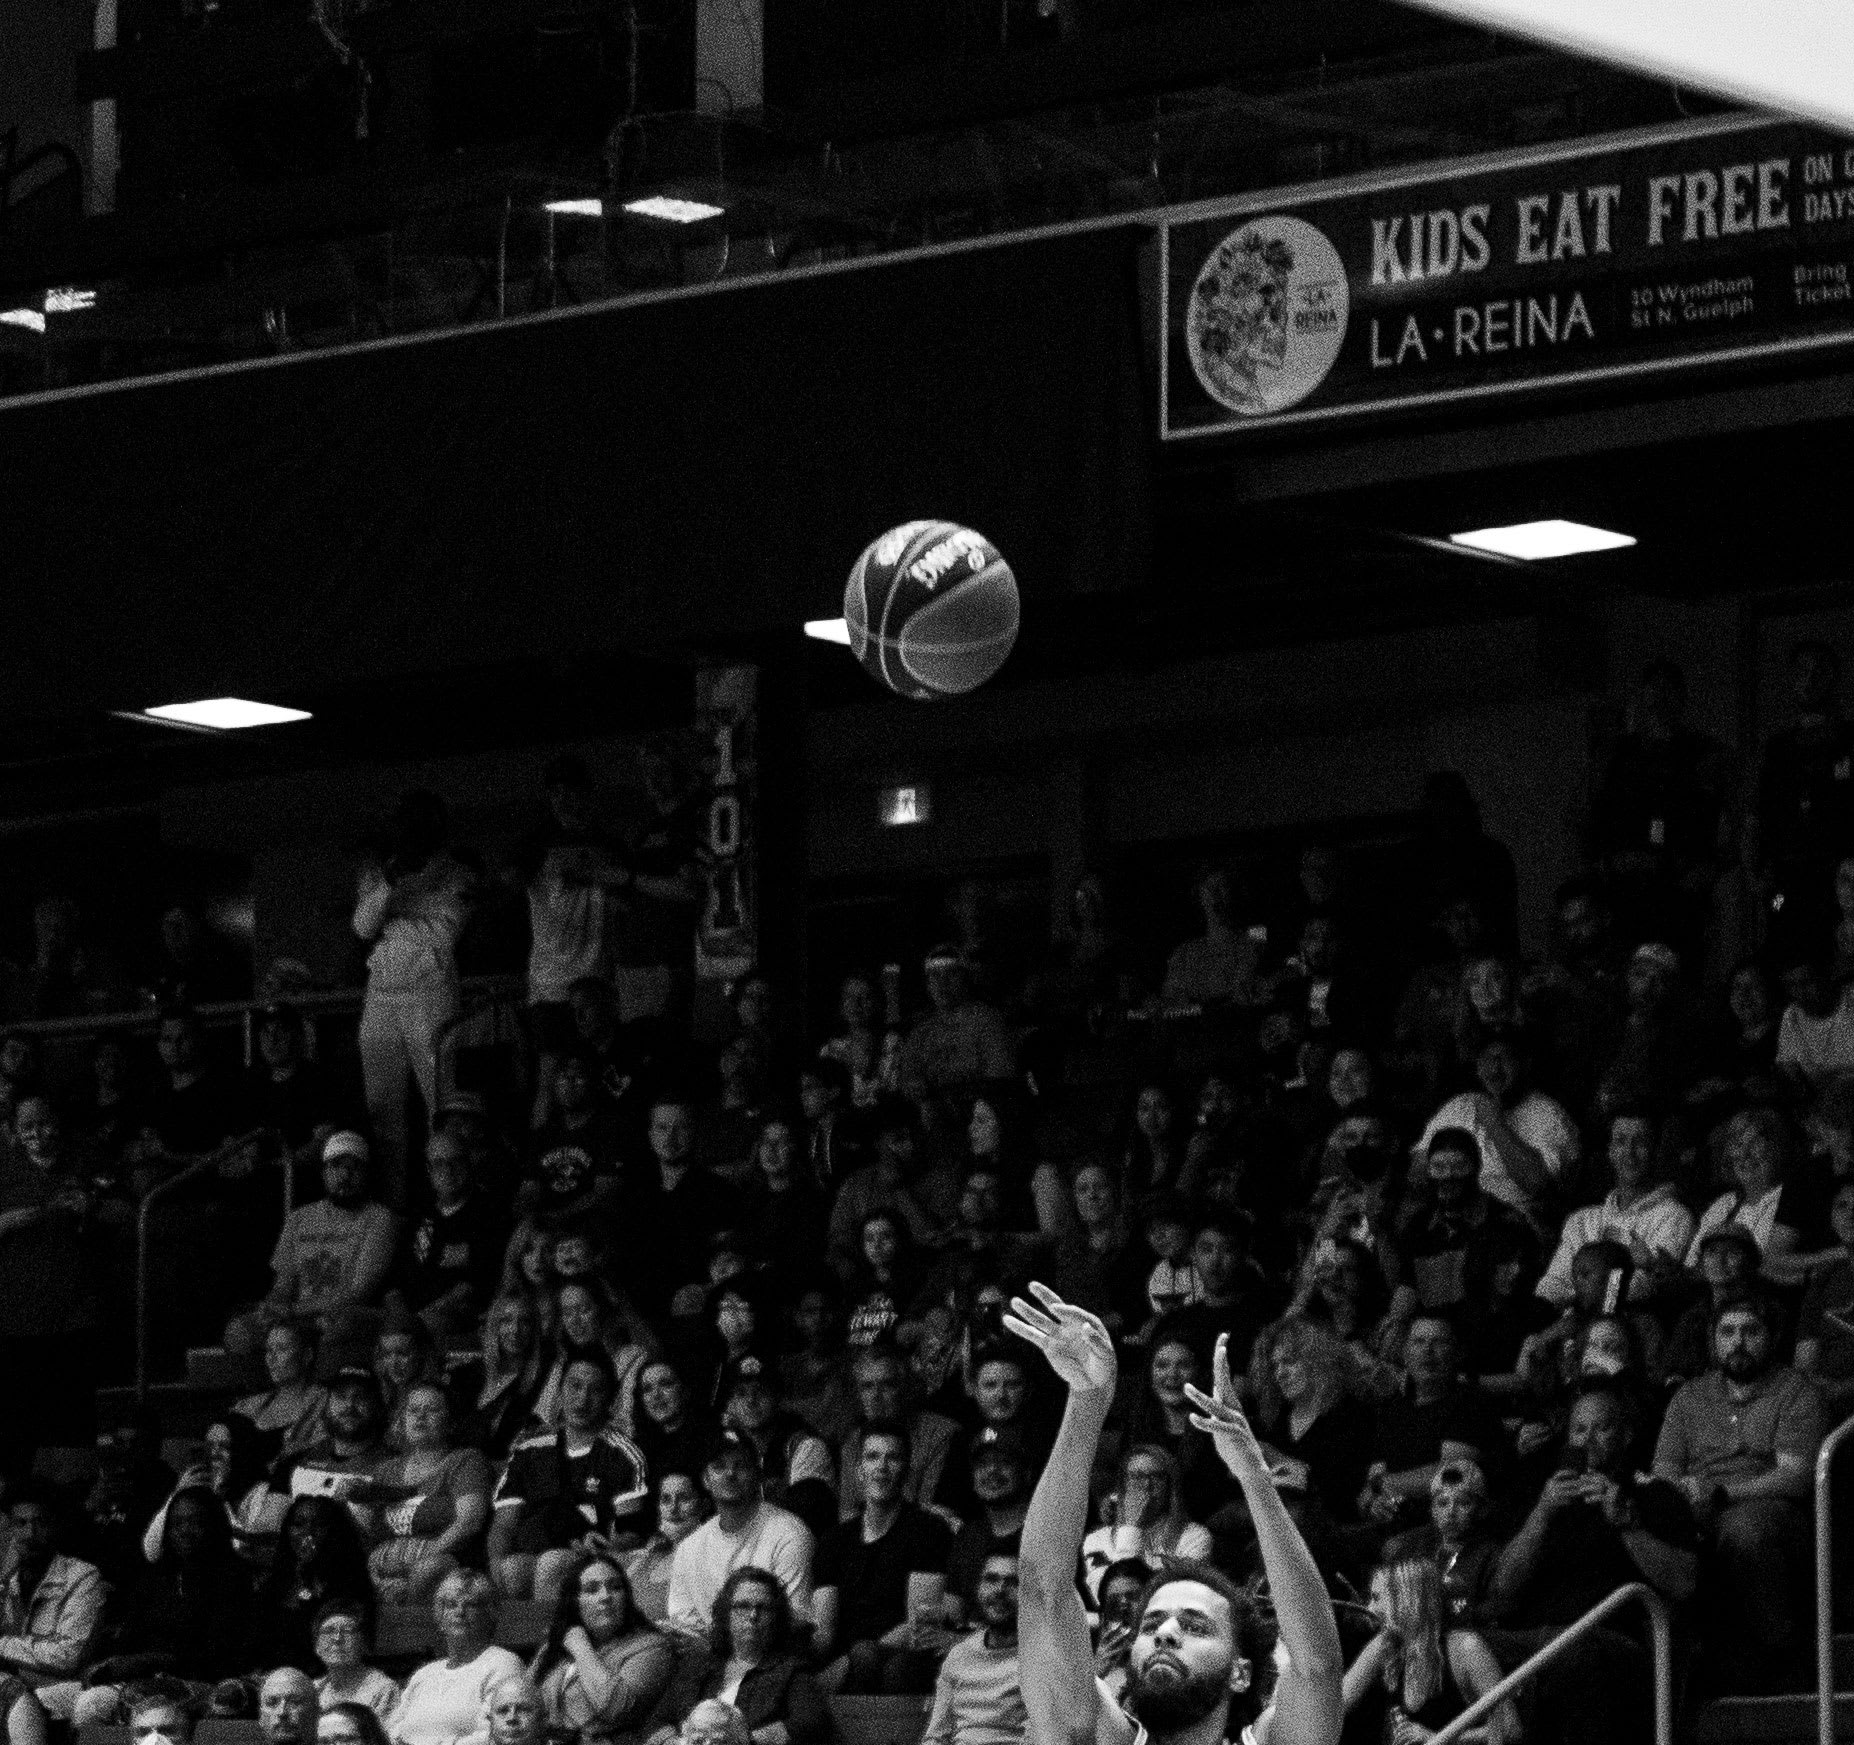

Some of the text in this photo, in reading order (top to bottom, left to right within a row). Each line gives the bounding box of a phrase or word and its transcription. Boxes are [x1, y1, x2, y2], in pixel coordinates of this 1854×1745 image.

[1803, 153, 1834, 185] ON
[1370, 158, 1792, 285] KIDS EAT FREE
[1793, 263, 1848, 285] Bring
[1656, 275, 1755, 303] Wyndham
[1794, 283, 1853, 306] Ticket
[1682, 296, 1755, 322] Guelph
